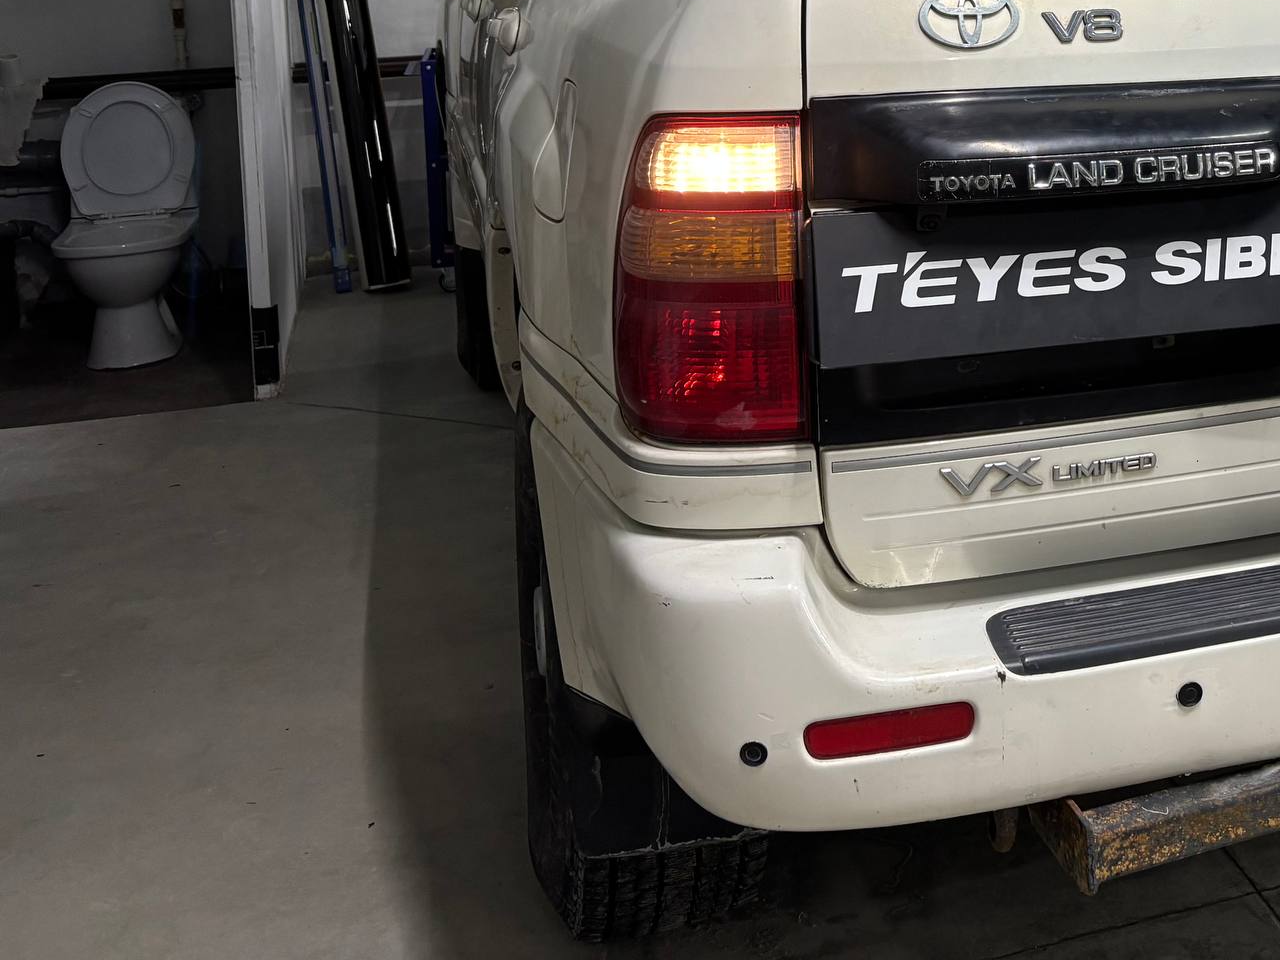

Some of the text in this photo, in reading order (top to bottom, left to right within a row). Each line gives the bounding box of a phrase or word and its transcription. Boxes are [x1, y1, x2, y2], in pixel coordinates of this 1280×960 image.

[1041, 8, 1123, 44] V8
[930, 148, 1276, 192] TOYOTA LAND CRUISER
[939, 452, 1157, 497] VX LIMITED
